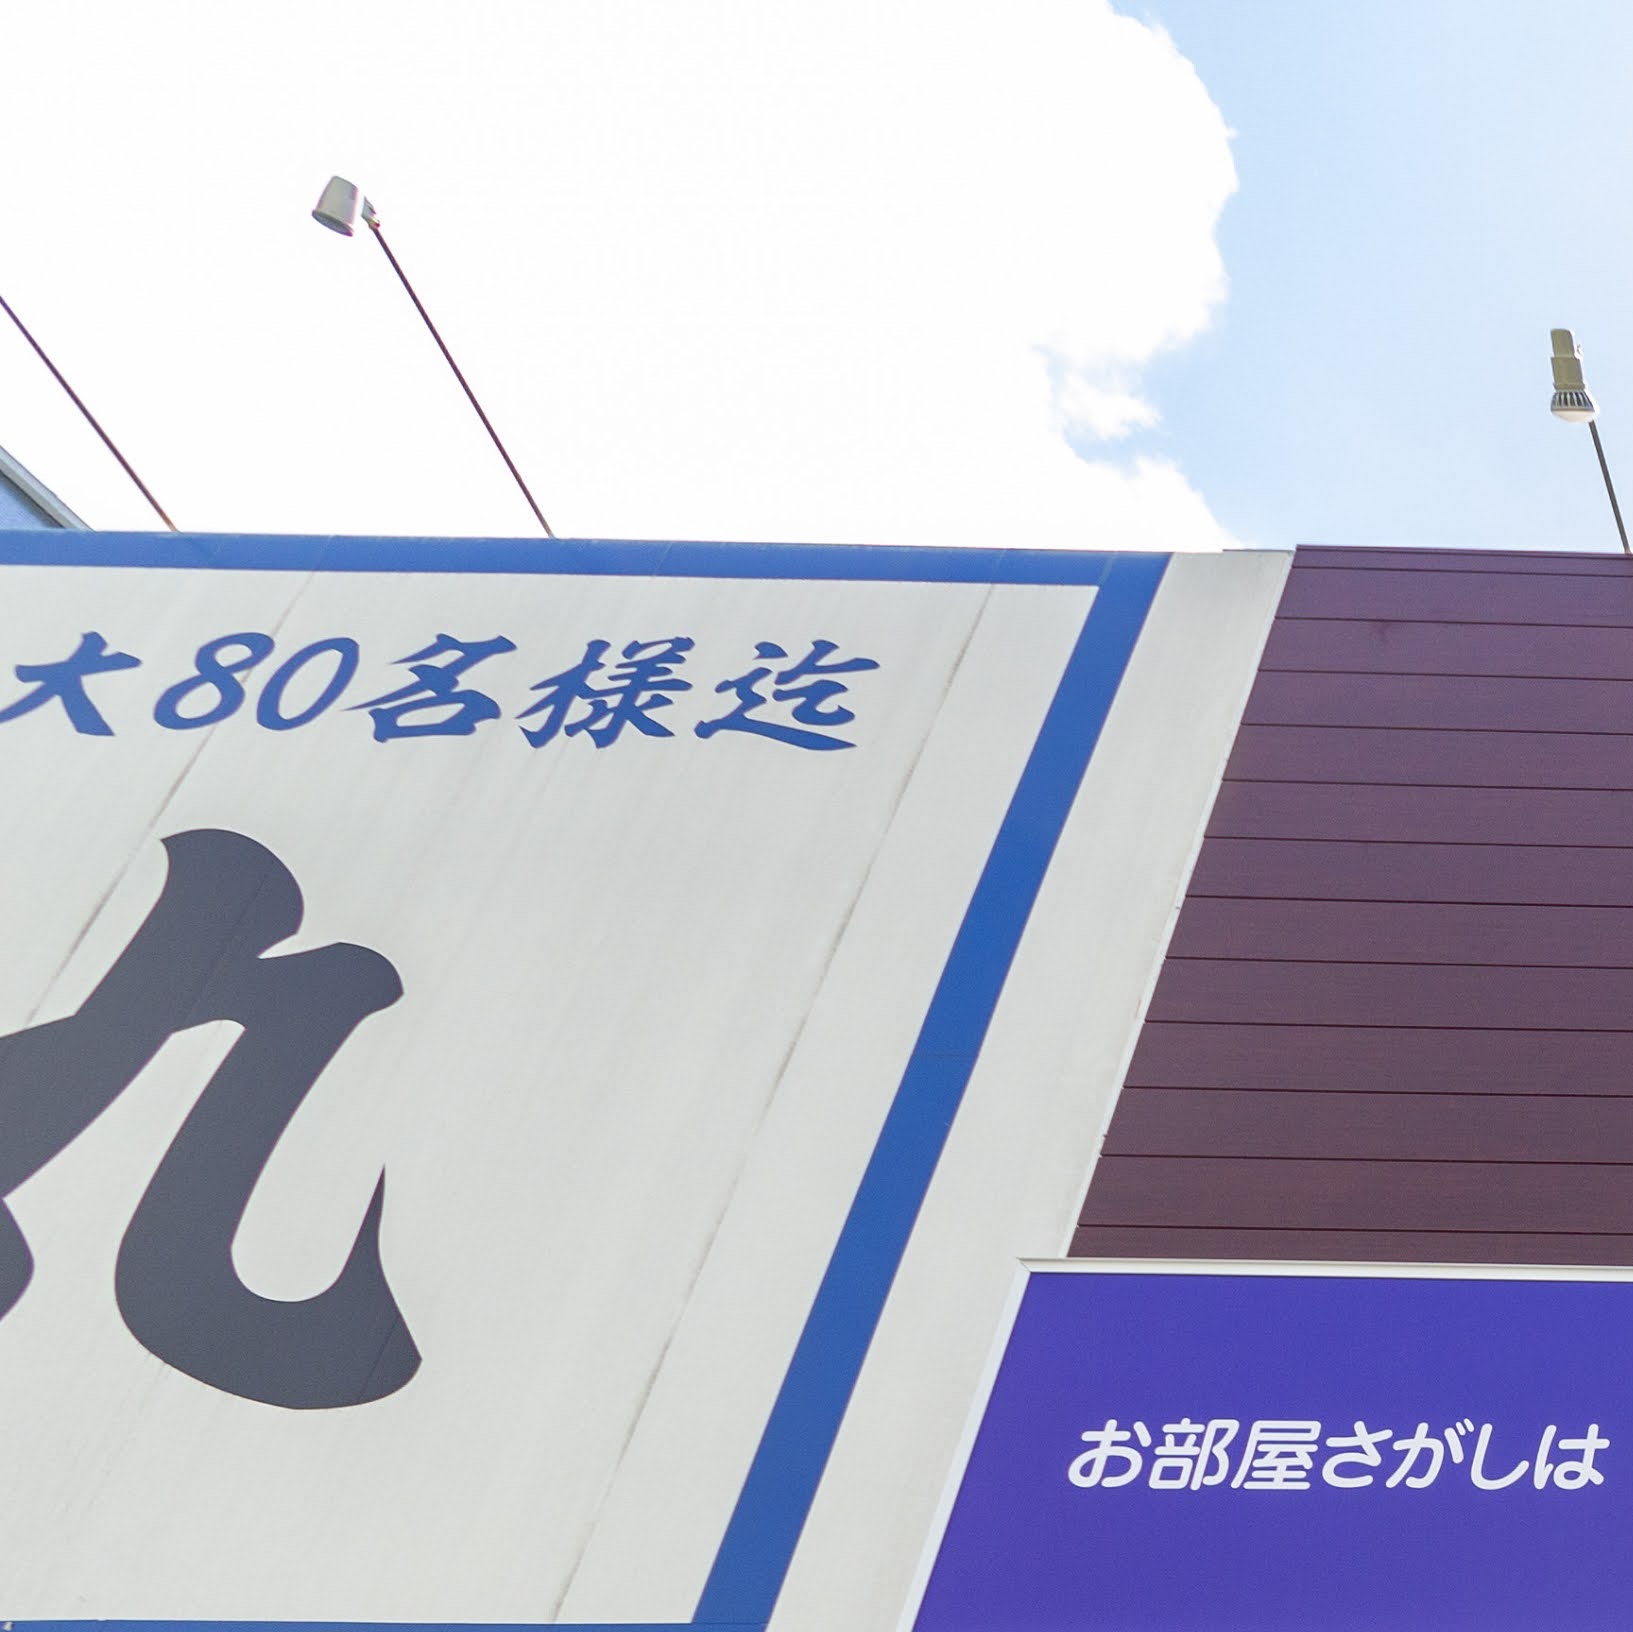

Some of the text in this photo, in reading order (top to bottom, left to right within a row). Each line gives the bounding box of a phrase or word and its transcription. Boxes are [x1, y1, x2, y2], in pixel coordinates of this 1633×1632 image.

[1067, 1417, 1611, 1491] お部屋さがしは
